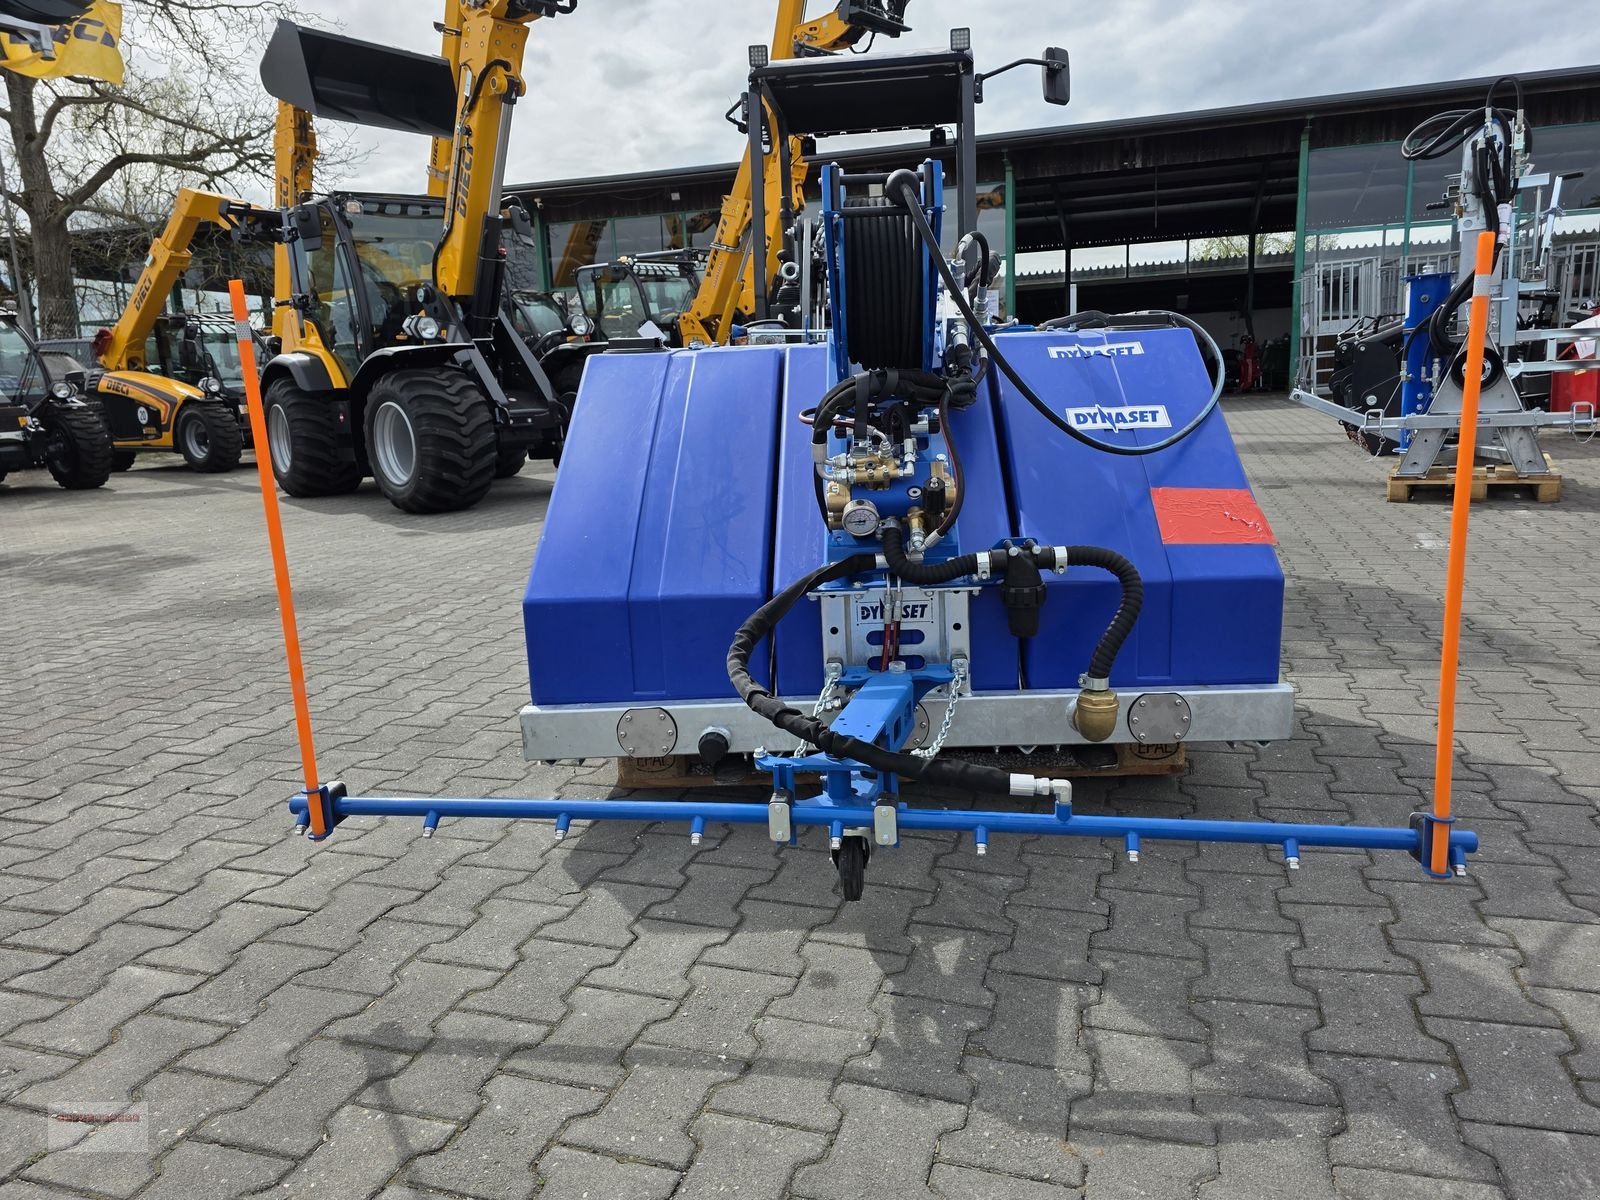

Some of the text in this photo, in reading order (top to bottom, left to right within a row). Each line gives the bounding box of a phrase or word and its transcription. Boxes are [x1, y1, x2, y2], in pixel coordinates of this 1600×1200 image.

[9, 17, 116, 49] ECI
[279, 175, 289, 208] ECI
[133, 274, 152, 312] DIECI
[106, 380, 129, 396] DIECI
[1074, 407, 1160, 429] DYNASET
[860, 598, 928, 620] DYSET
